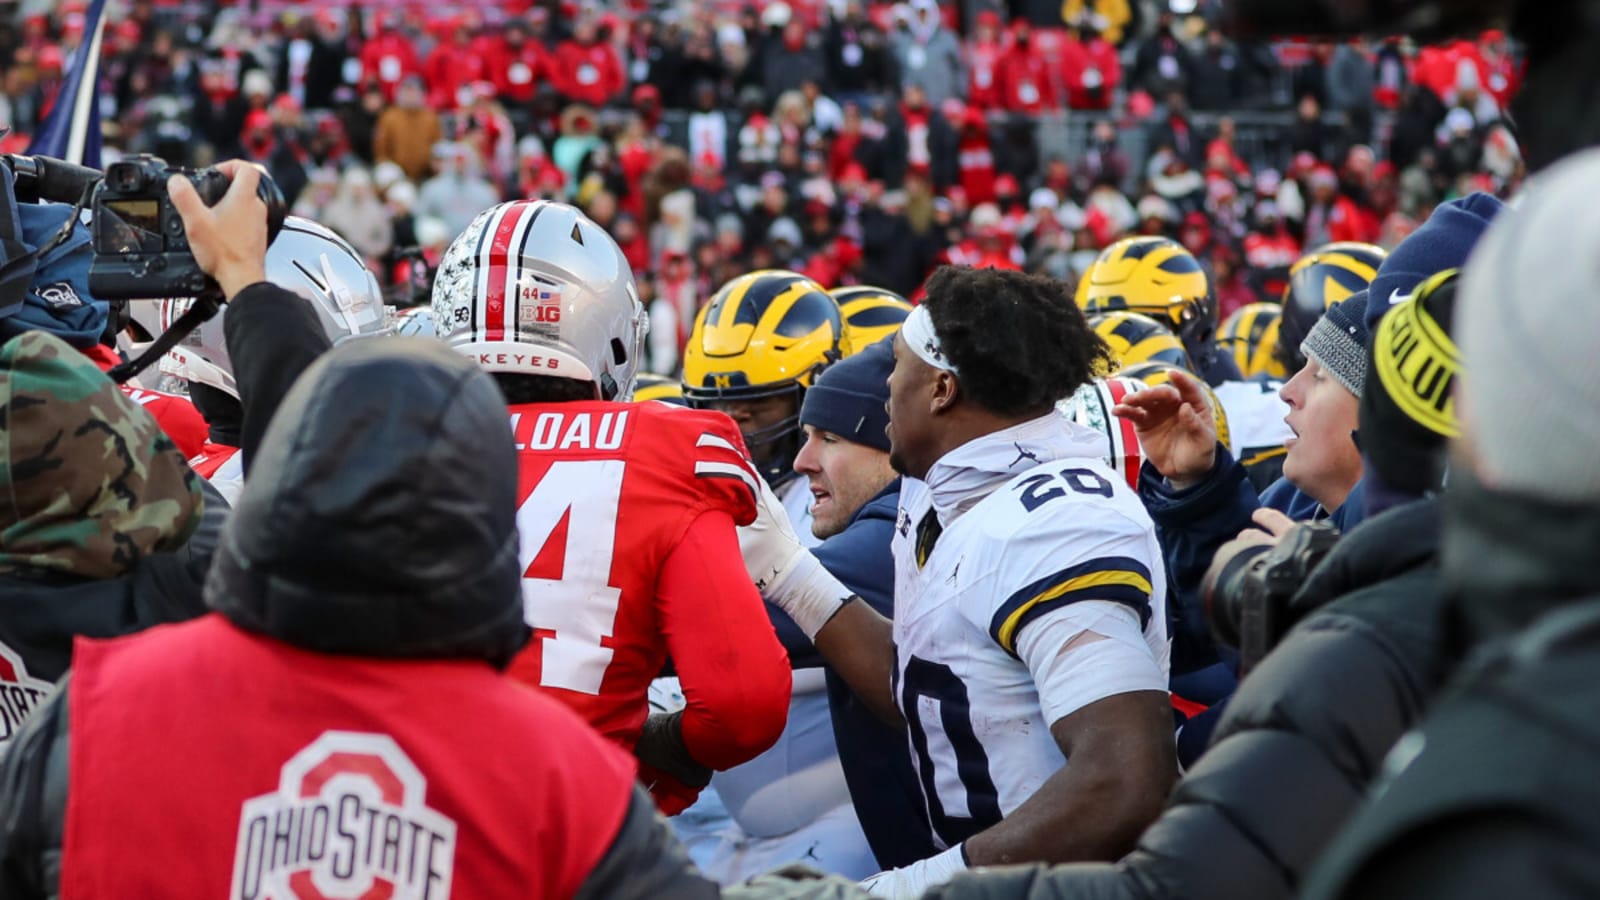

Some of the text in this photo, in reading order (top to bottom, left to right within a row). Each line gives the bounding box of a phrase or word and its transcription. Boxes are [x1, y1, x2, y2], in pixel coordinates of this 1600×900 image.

[522, 287, 538, 300] 44
[467, 353, 559, 369] KEYES
[1012, 468, 1114, 512] 20
[515, 460, 626, 696] 4
[892, 654, 1004, 848] 0
[332, 794, 446, 900] STATE
